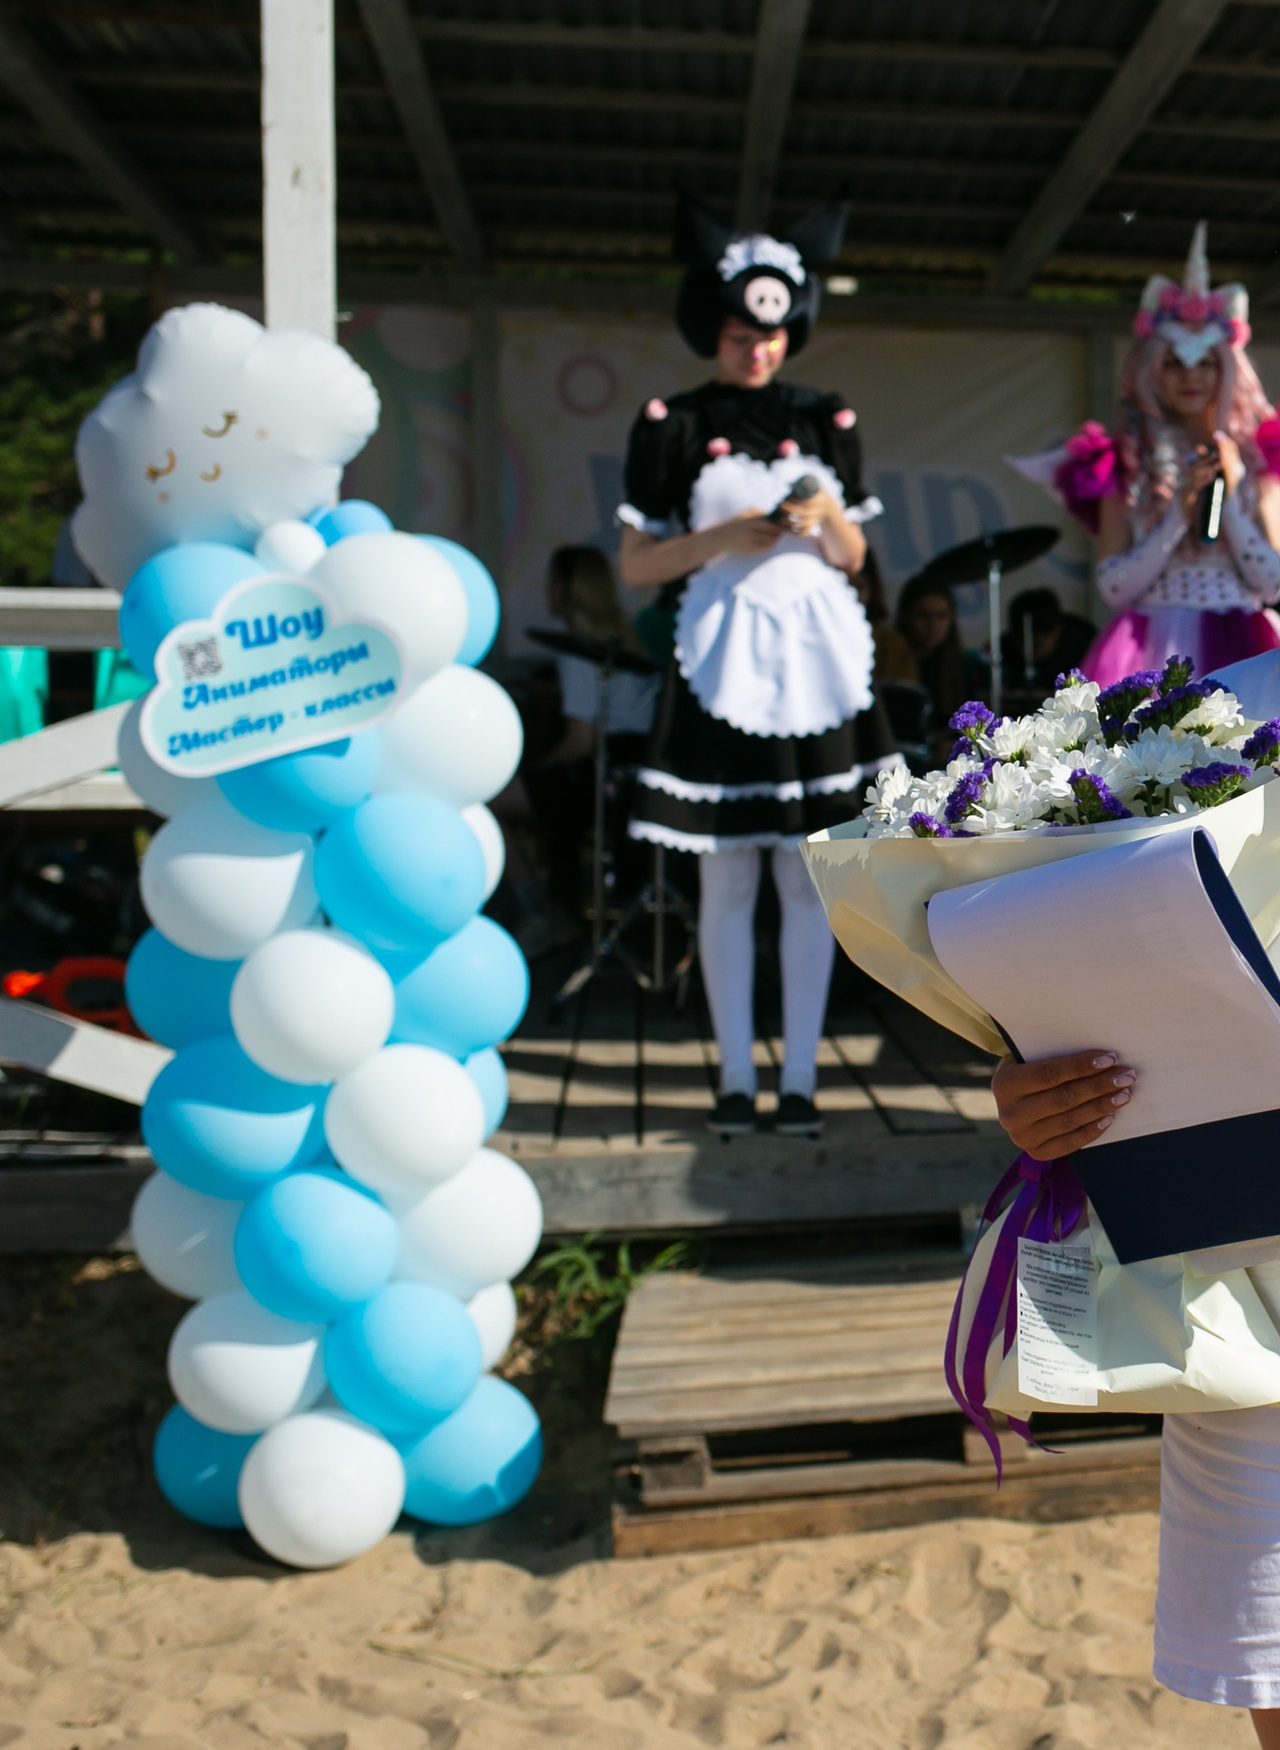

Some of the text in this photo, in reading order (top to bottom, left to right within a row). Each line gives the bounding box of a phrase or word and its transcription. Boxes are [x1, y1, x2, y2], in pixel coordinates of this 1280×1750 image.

[225, 606, 325, 650] Шоу
[183, 641, 370, 711] Аниматоры
[168, 711, 285, 757] Мастер
[303, 678, 396, 717] классы
